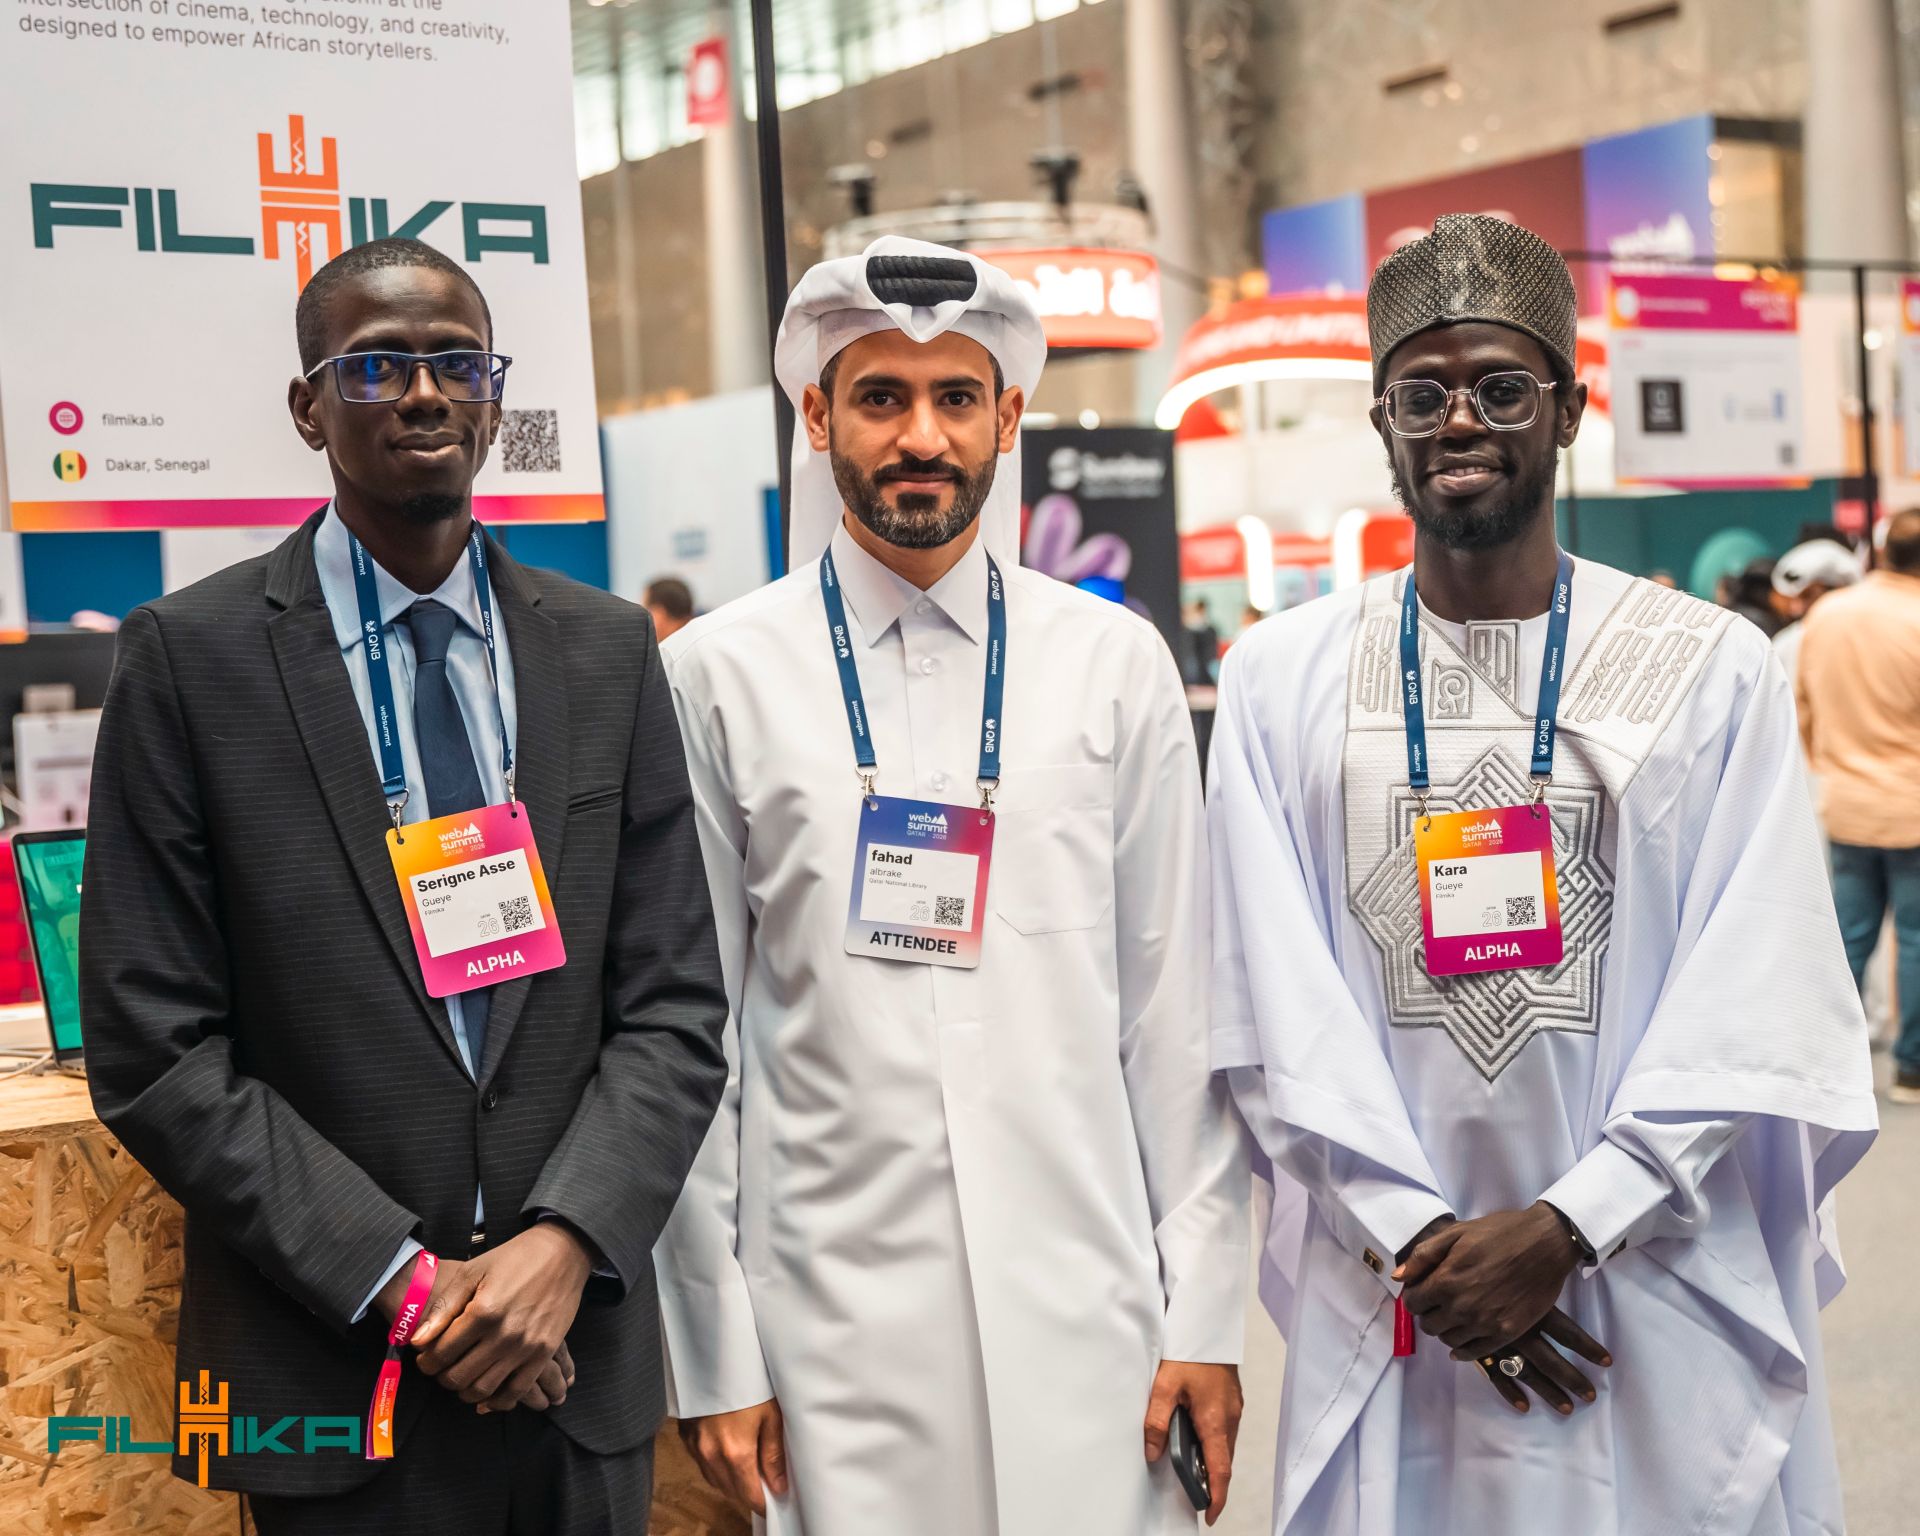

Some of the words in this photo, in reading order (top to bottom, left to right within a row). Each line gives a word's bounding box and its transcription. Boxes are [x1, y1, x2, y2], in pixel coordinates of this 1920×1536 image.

[149, 0, 170, 16] of
[176, 1, 255, 25] cinema,
[262, 7, 374, 34] technology,
[379, 17, 414, 34] and
[420, 20, 509, 45] creativity,
[19, 14, 117, 39] designed
[125, 24, 145, 40] to
[152, 27, 244, 47] empower
[252, 31, 321, 52] African
[327, 38, 438, 61] storytellers.
[102, 413, 165, 427] filmika.io
[105, 458, 151, 473] Dakar,
[154, 458, 211, 474] Senegal
[991, 580, 1000, 601] QNB
[1557, 583, 1568, 604] QNB
[483, 611, 492, 637] QNB
[834, 625, 847, 647] QNB
[367, 634, 381, 661] QNB
[1548, 647, 1558, 682] websummit
[1409, 682, 1418, 705] QNB
[380, 704, 392, 748] websummit
[852, 700, 864, 737] websummit
[1539, 719, 1550, 743] QNB
[984, 730, 995, 753] QNB
[907, 821, 948, 834] summit
[908, 812, 932, 823] web
[1461, 821, 1485, 833] web
[438, 827, 463, 842] web
[441, 833, 484, 851] summit
[1462, 829, 1503, 842] summit
[871, 849, 913, 866] fahad
[417, 870, 476, 892] Serigne
[479, 860, 516, 878] Asse
[870, 867, 902, 878] albrake
[1434, 865, 1467, 877] Kara
[1436, 882, 1463, 891] Gueye
[422, 894, 452, 908] Gueye
[910, 904, 931, 922] 26
[1481, 910, 1502, 928] 26
[477, 918, 500, 937] 26
[869, 930, 958, 955] ATTENDEE
[1464, 942, 1522, 961] ALPHA
[466, 950, 526, 977] ALPHA
[394, 1302, 420, 1342] ALPHA
